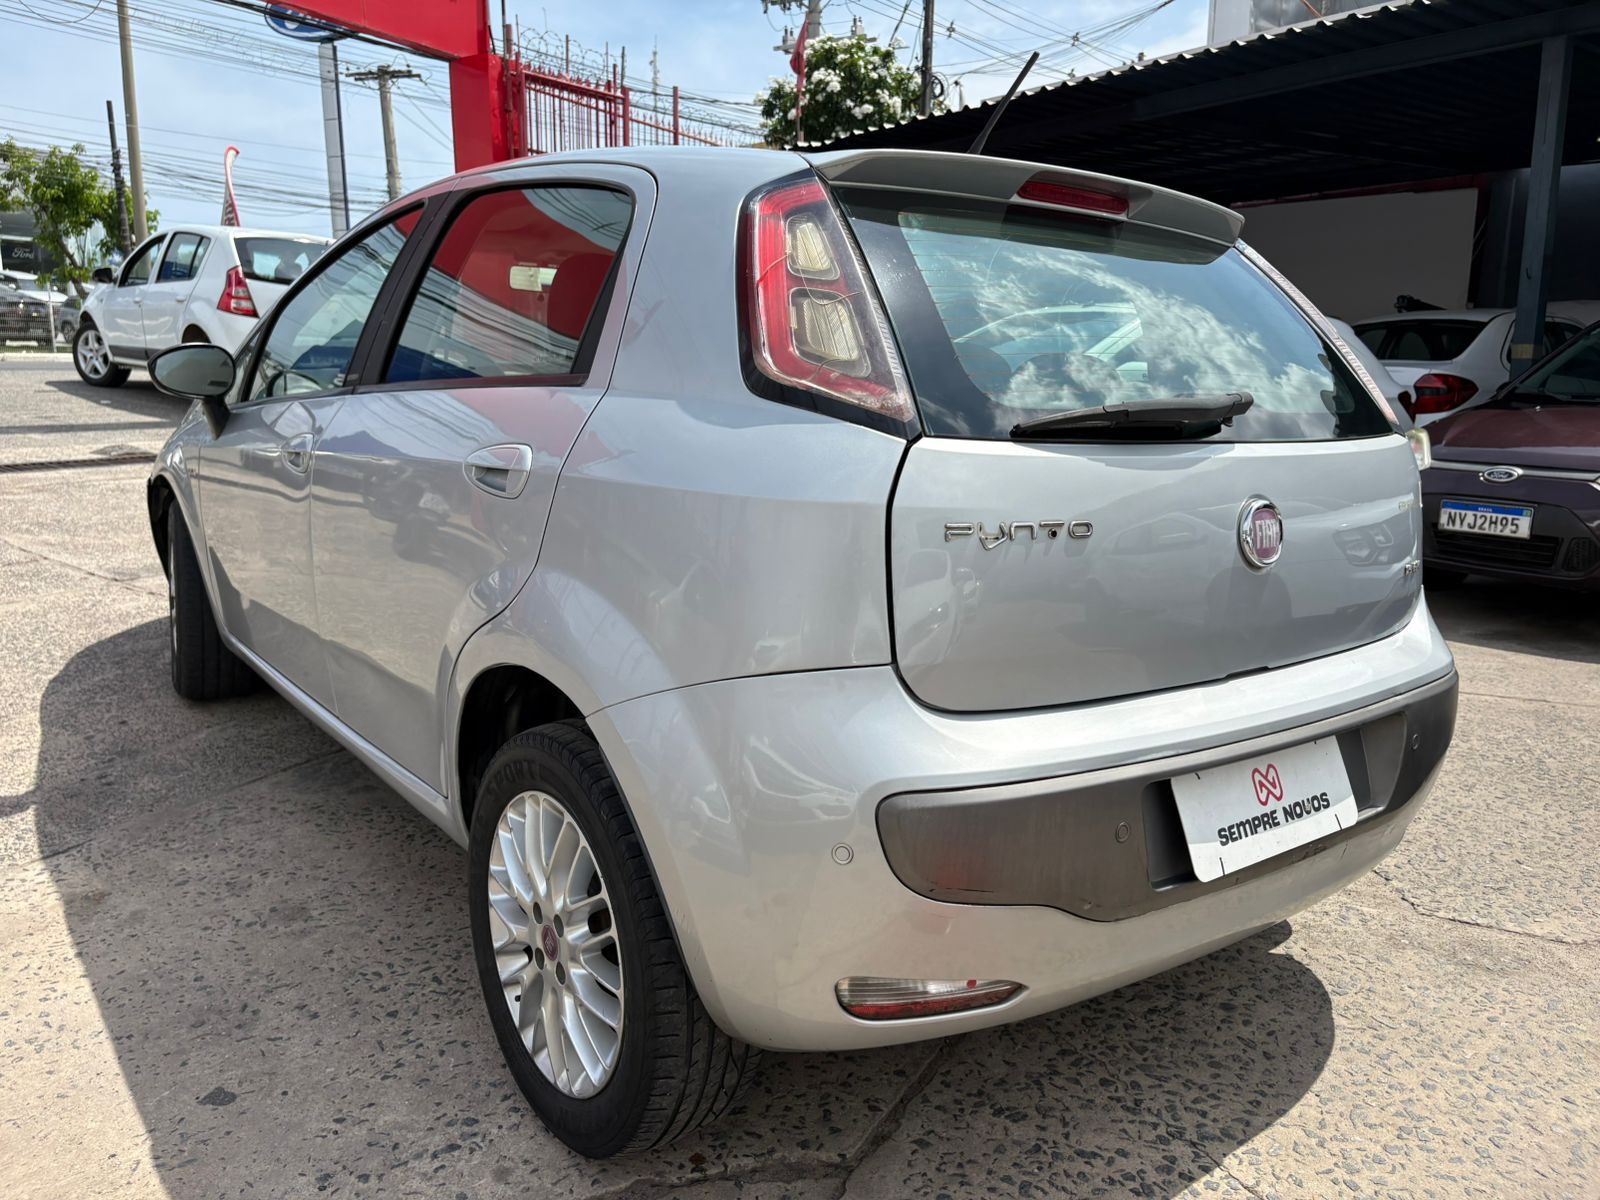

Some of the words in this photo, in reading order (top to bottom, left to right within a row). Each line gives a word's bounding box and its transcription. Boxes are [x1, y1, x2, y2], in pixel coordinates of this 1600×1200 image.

[12, 247, 34, 259] Ford
[1255, 519, 1280, 549] FIAT
[1446, 511, 1520, 534] NYJ2H95
[1217, 809, 1280, 847] SEMPRE
